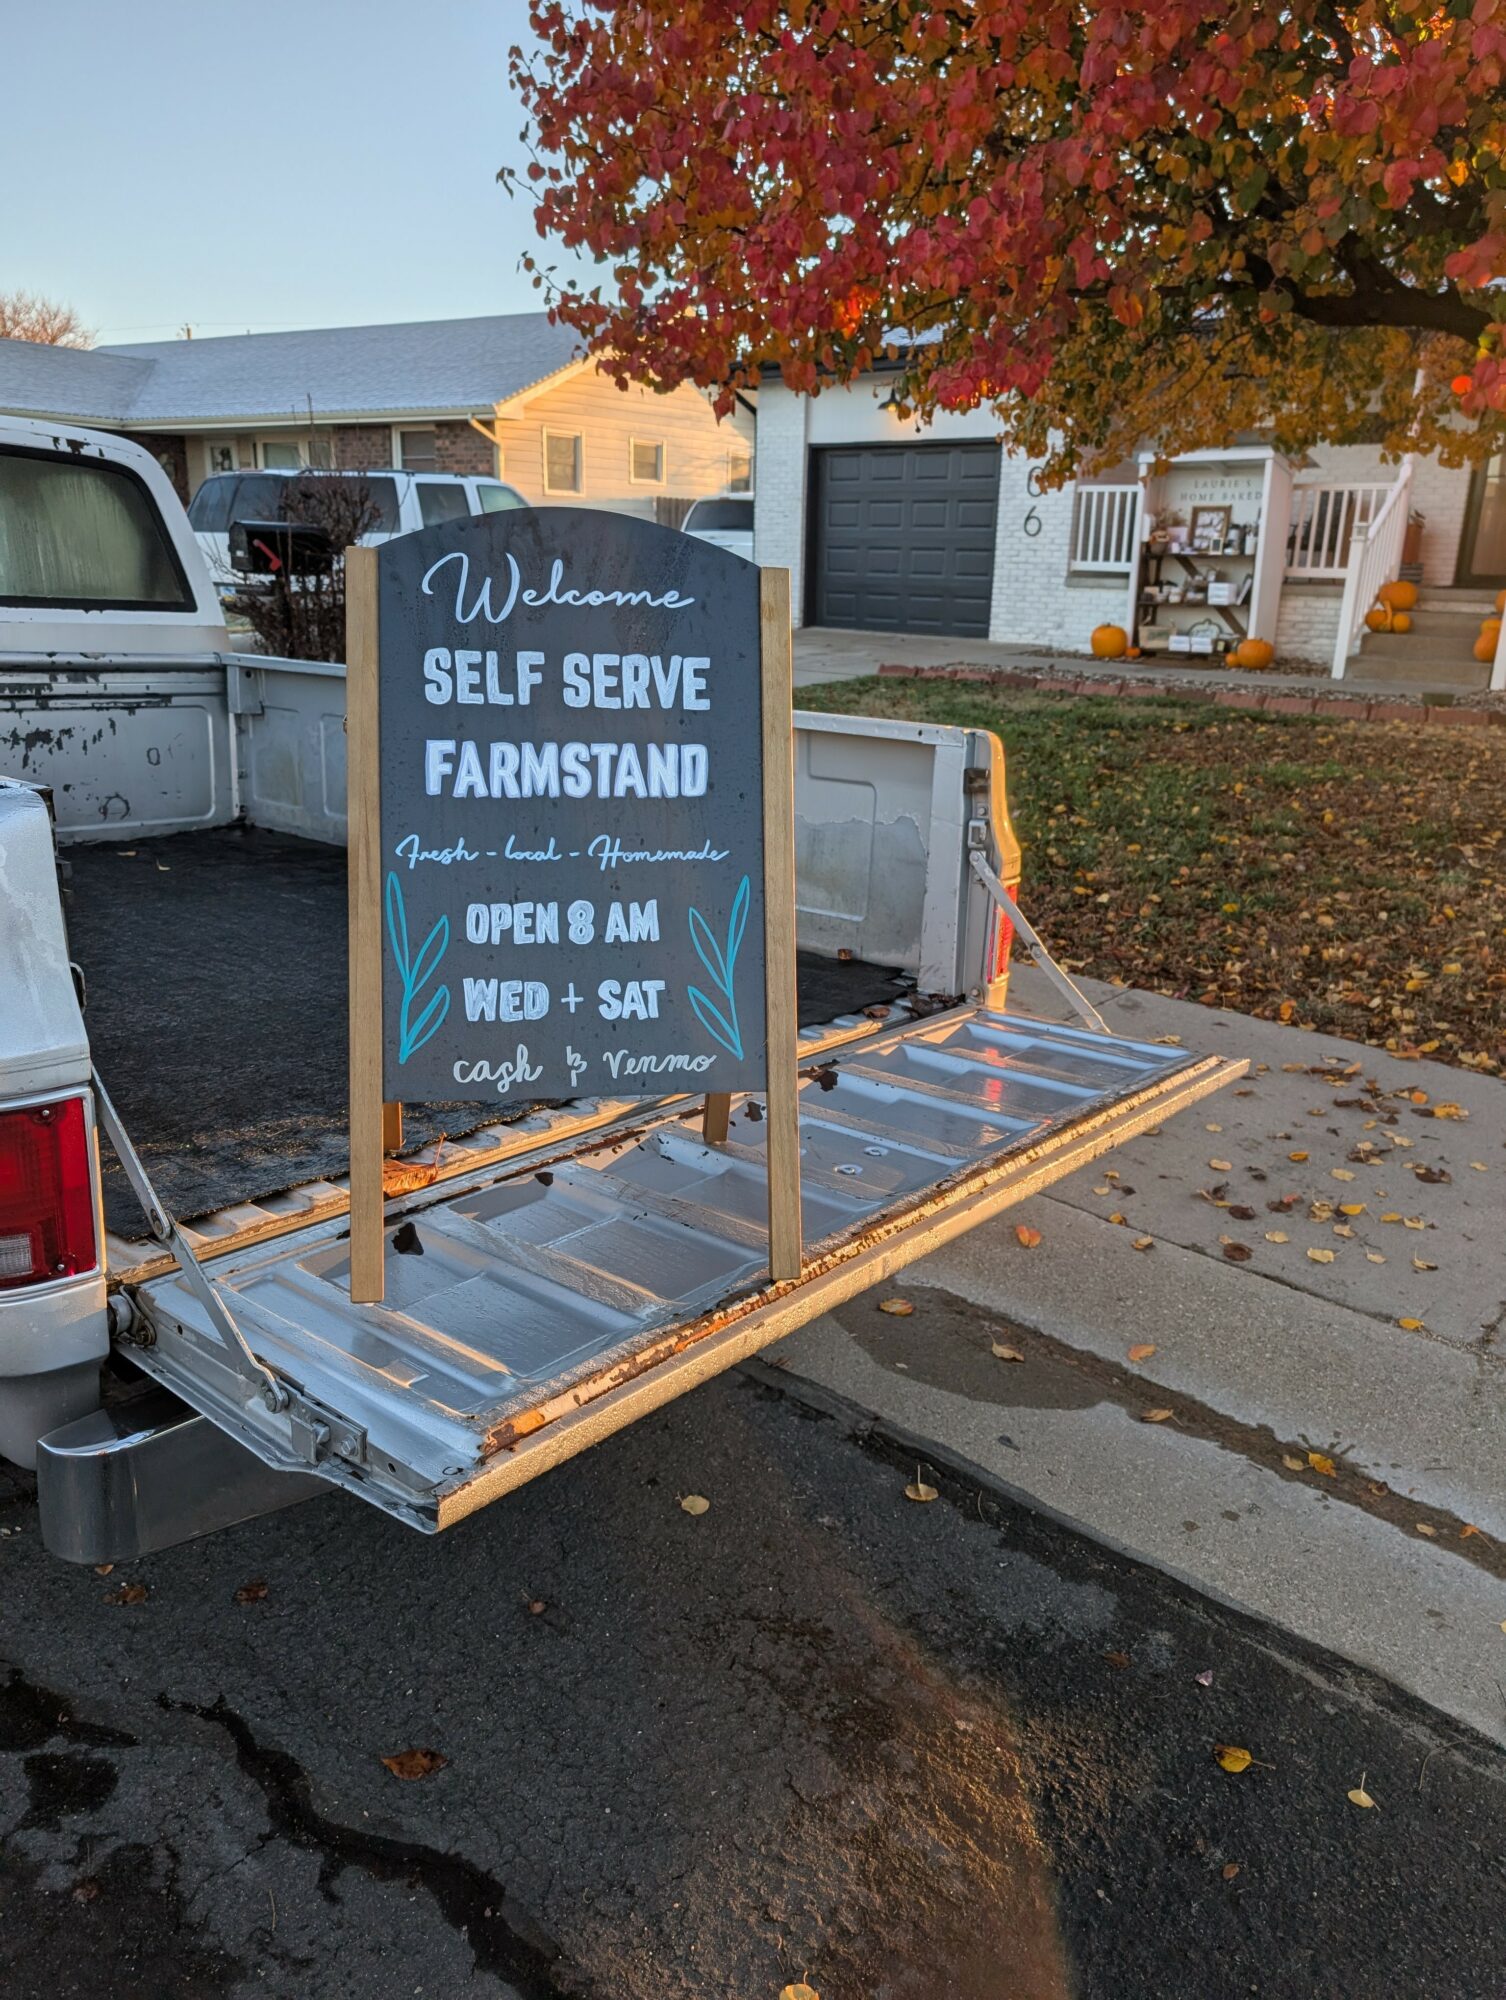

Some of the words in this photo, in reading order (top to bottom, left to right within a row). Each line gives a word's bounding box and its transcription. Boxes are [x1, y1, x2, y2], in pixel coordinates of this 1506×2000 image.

[1180, 490, 1216, 502] HOME
[1222, 491, 1263, 501] BAKED
[421, 552, 695, 624] Welcome
[423, 647, 546, 706] SELF
[562, 652, 711, 711] SERVE
[424, 739, 709, 799] FARMSTAND
[394, 834, 480, 870] Fresh
[587, 834, 730, 871] Homemade
[465, 901, 560, 946] OPEN
[566, 899, 595, 945] 8
[604, 898, 660, 944] AM
[462, 977, 550, 1023] WED
[560, 982, 584, 1014] +
[597, 979, 666, 1021] SAT
[453, 1043, 544, 1094] cash
[602, 1049, 718, 1079] Venmo
